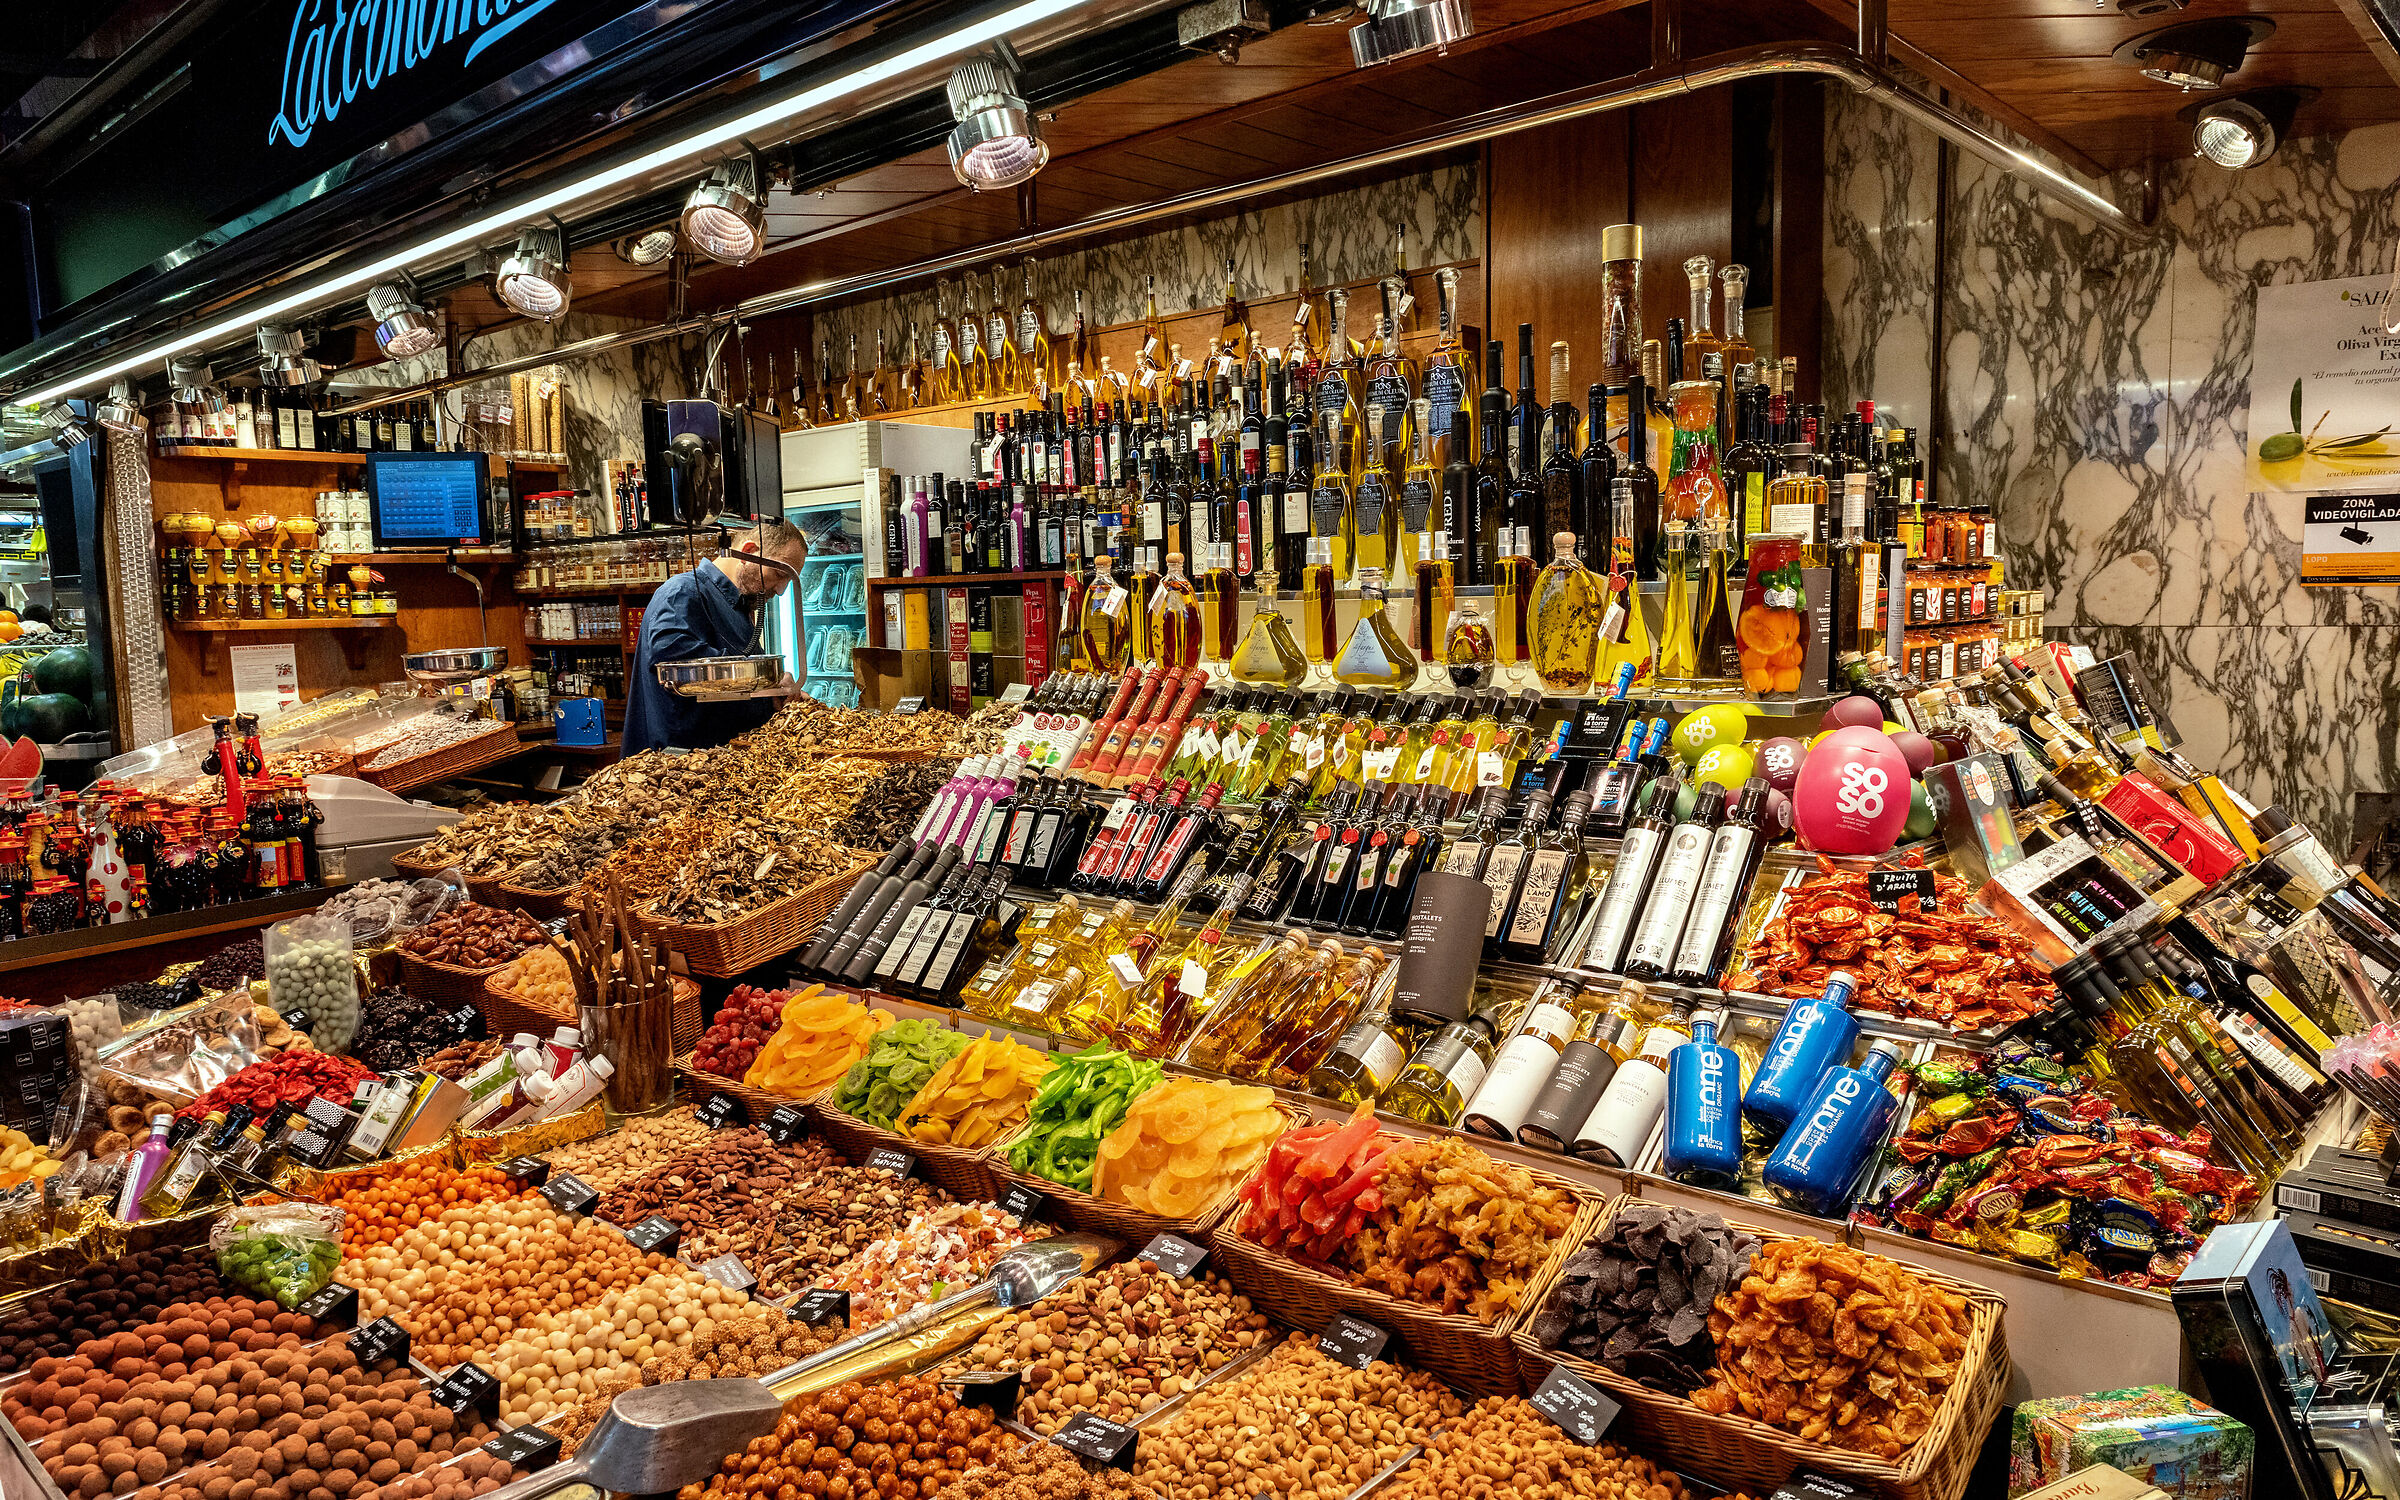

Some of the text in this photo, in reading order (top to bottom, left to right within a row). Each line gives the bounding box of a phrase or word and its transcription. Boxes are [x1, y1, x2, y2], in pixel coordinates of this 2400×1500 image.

[2337, 336, 2400, 351] Oliva Virg
[2380, 350, 2400, 361] Ext
[2326, 367, 2359, 379] remedio
[2360, 365, 2394, 376] natural
[237, 410, 249, 421] sal
[2326, 468, 2400, 478] www.lasahita.co
[2342, 499, 2375, 508] ZONA
[2313, 508, 2400, 520] VIDEOVIGILADA
[1595, 714, 1610, 722] finca
[1764, 744, 1792, 759] SO
[1766, 755, 1794, 771] SO
[1841, 762, 1888, 794] SO
[1836, 786, 1884, 819] SO
[1884, 873, 1917, 883] FRUITA
[1492, 883, 1508, 892] AMO
[1526, 888, 1551, 898] L'AMO
[1561, 1061, 1591, 1077] HOSTALETS
[1826, 1109, 1845, 1135] ORGANIC
[1705, 1142, 1723, 1151] torre
[1708, 1137, 1723, 1145] finca
[872, 1158, 906, 1169] NATURAL
[1796, 1160, 1811, 1171] finca
[1791, 1163, 1808, 1176] torre
[1340, 1319, 1377, 1339] ANACARD
